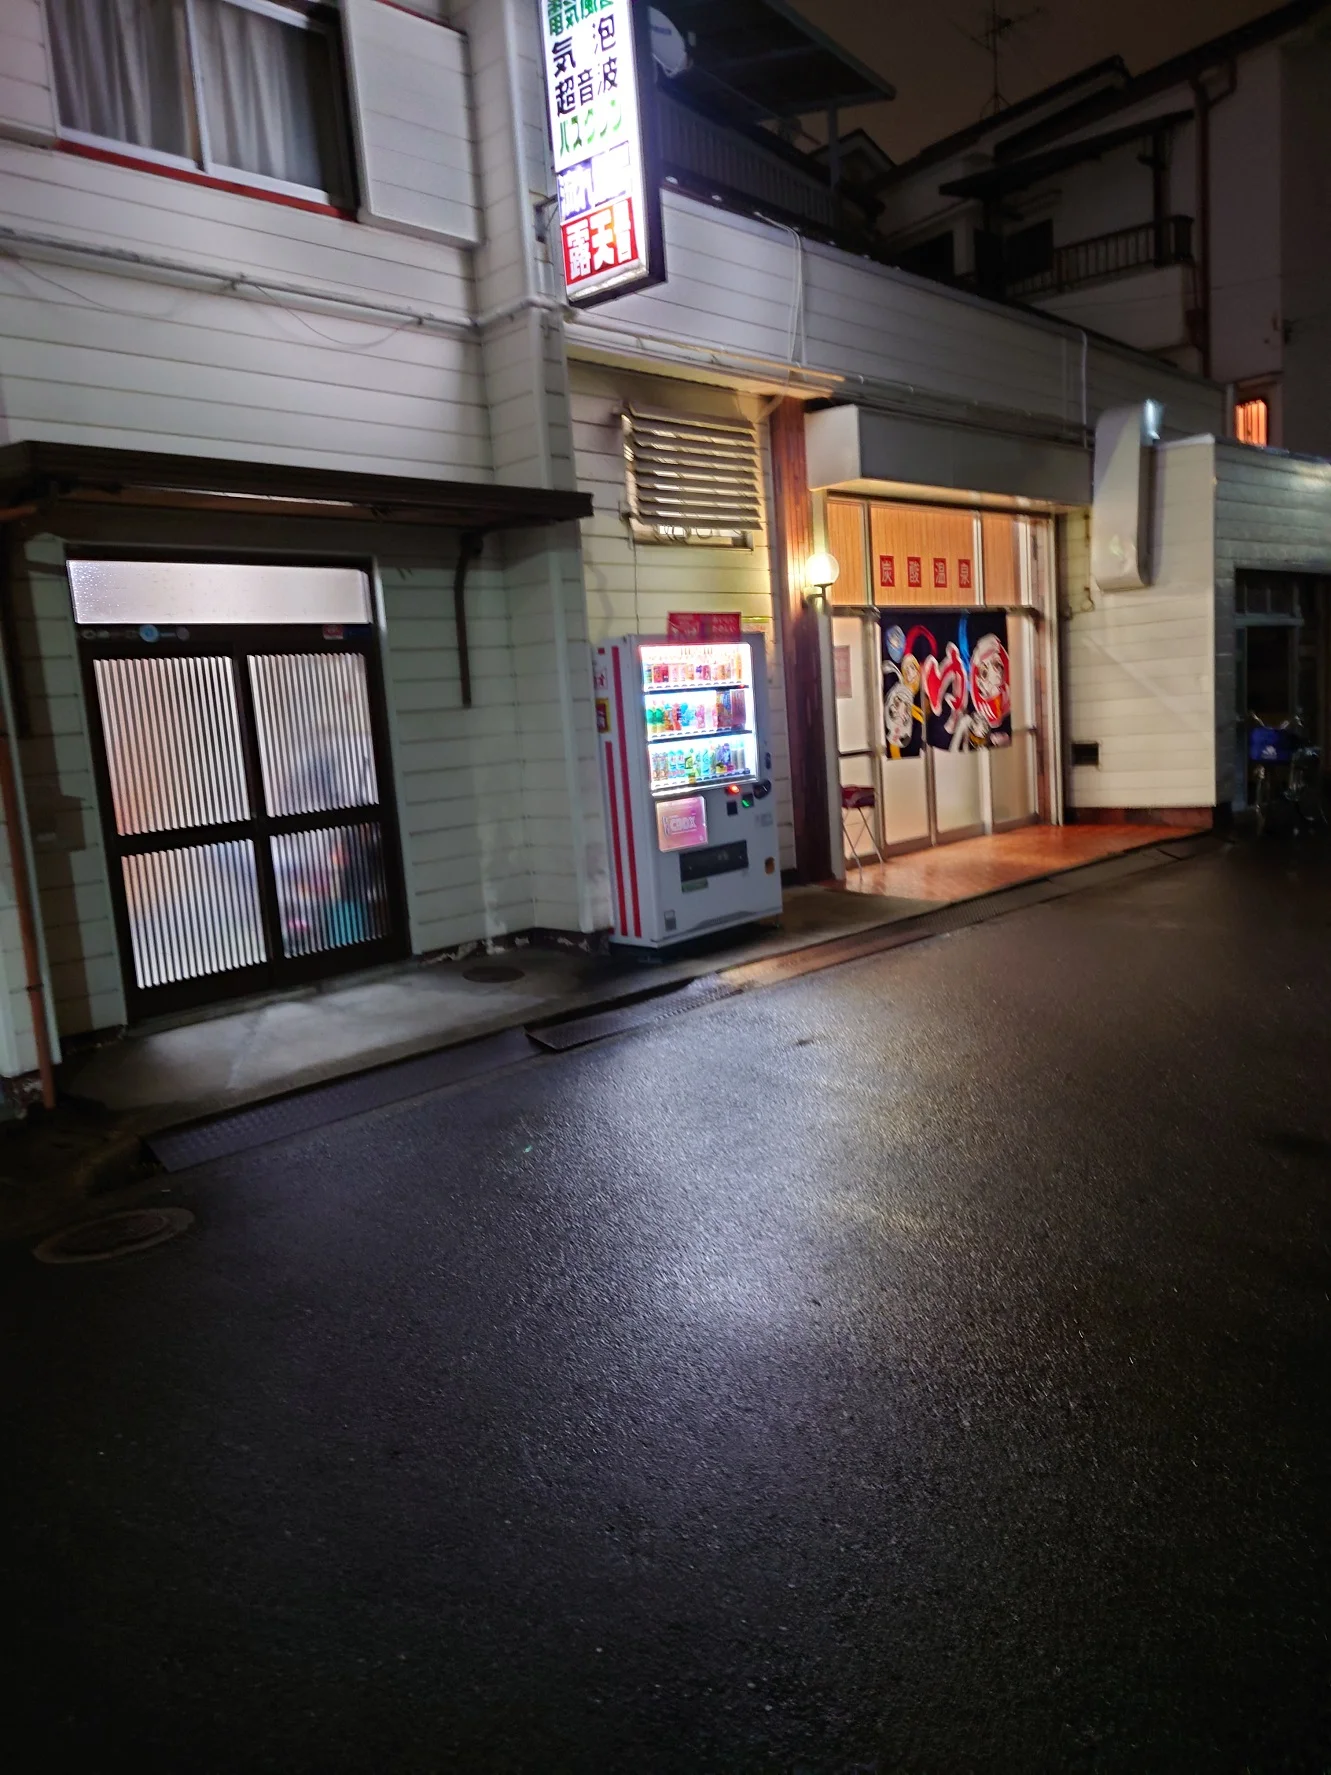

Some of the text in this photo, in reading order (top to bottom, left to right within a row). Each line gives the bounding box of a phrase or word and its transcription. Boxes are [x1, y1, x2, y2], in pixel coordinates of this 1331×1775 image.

[547, 0, 614, 37] 電気風
[554, 56, 619, 117] 超音波
